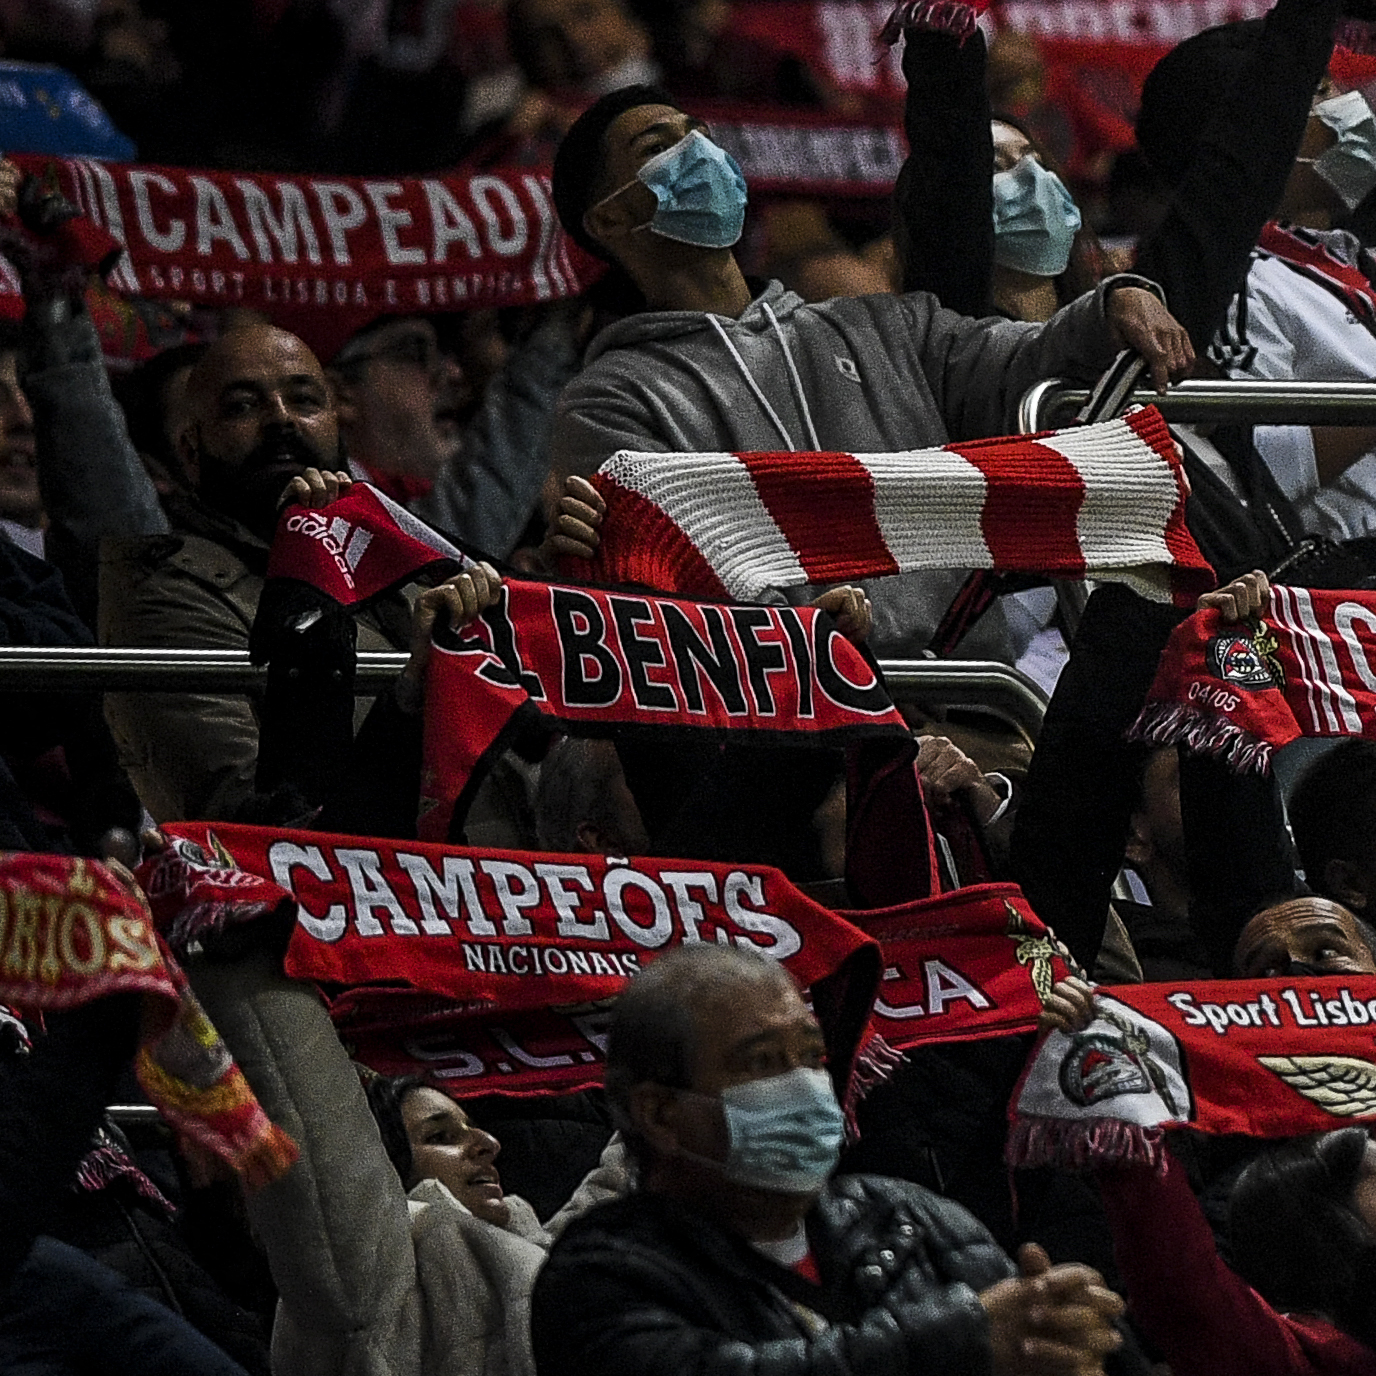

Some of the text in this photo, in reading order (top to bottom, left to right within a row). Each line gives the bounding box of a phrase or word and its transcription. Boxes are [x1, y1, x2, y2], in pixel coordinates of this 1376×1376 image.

[286, 512, 356, 590] adidas
[1186, 678, 1239, 714] 04/05
[268, 840, 803, 961] CAMPEÕES
[461, 943, 642, 977] NACIONAIS
[1166, 990, 1280, 1035] Sport
